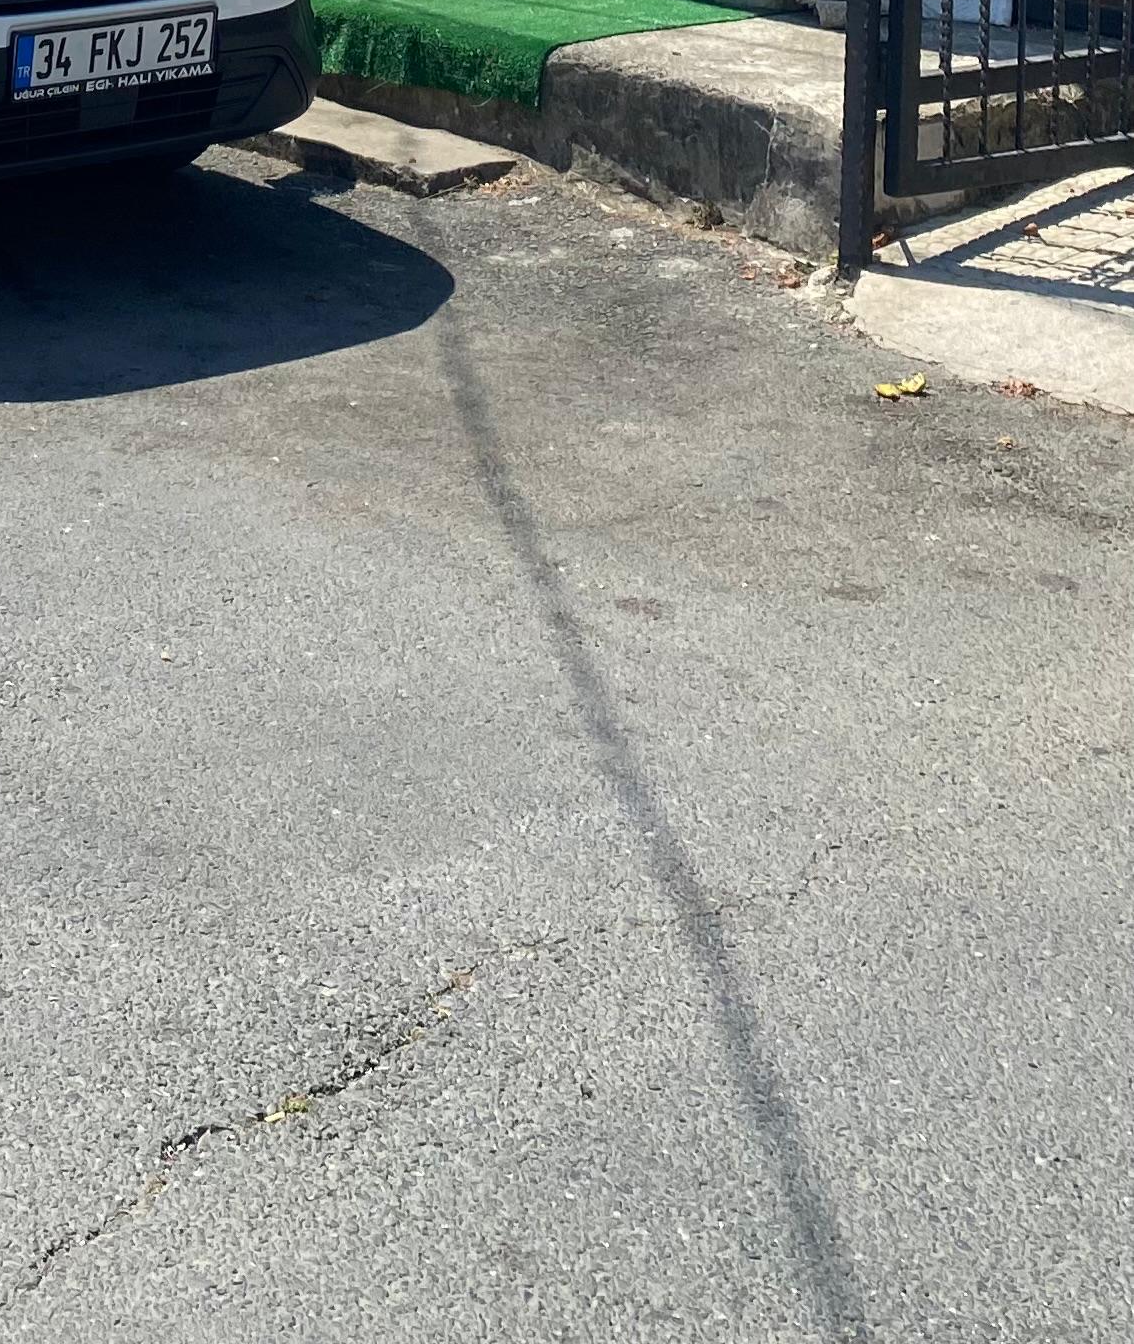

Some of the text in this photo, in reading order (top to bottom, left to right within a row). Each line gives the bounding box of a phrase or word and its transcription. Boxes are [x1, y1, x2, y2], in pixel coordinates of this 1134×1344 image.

[17, 18, 208, 80] TR 34 FKJ 252
[118, 73, 151, 88] HALI
[155, 63, 213, 82] YIKAMA
